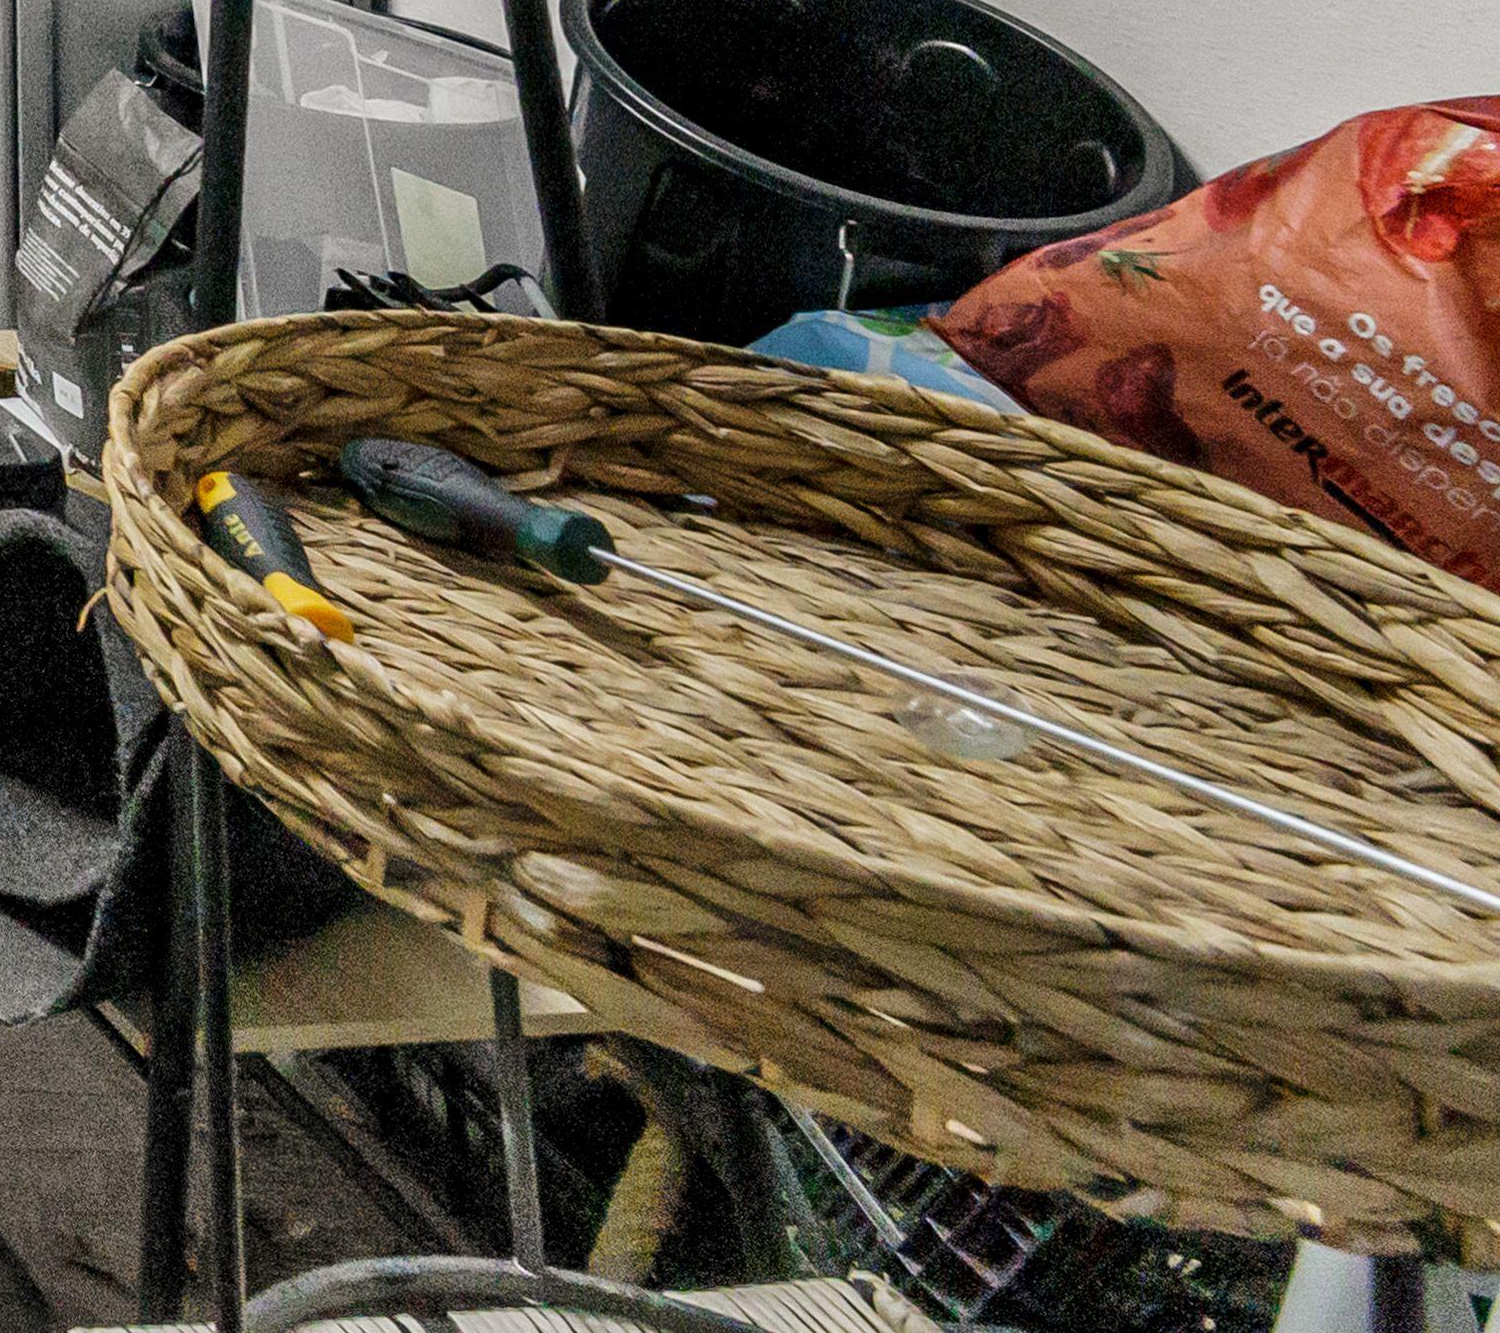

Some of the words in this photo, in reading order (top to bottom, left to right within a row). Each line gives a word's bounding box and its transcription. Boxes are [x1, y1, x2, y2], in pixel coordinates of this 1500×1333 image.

[1348, 312, 1393, 357] Os
[1259, 283, 1316, 336] que
[1319, 337, 1347, 362] a
[1351, 363, 1413, 420] sua
[1423, 422, 1500, 501] des
[1291, 361, 1357, 420] não
